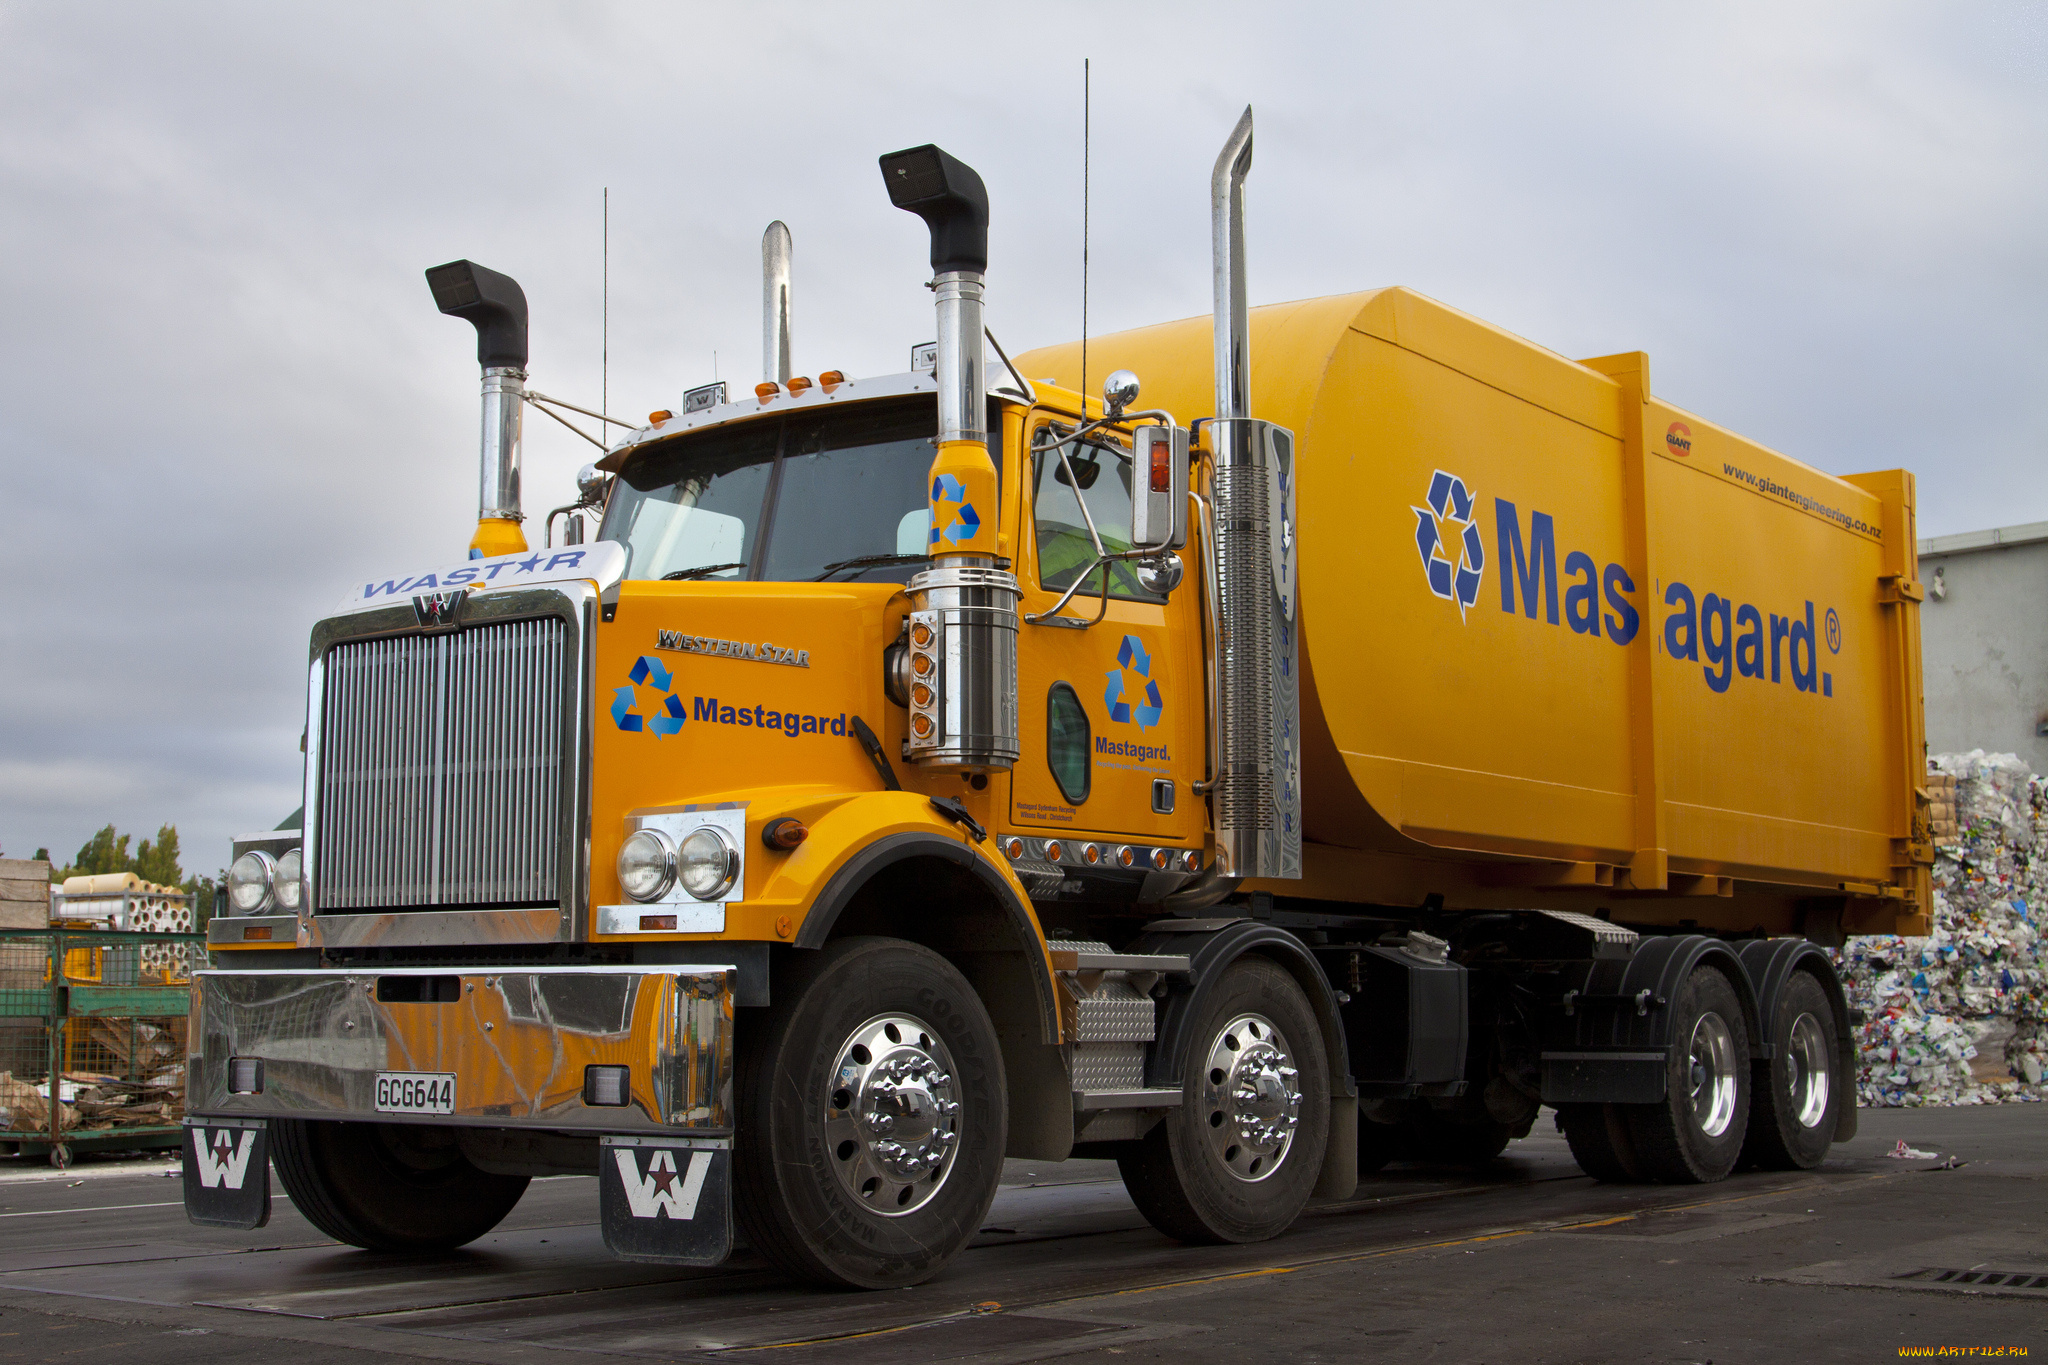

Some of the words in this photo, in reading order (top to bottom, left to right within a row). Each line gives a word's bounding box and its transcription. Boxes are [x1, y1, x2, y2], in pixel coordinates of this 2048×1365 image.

[1665, 433, 1692, 451] GIANT
[1723, 462, 1882, 539] www.giantengineering.co.nz
[657, 628, 757, 659] WESTERN
[759, 642, 810, 666] STAR
[693, 696, 854, 738] Mastagard.
[1095, 736, 1171, 762] Mastagard.
[377, 1078, 452, 1109] GCG644
